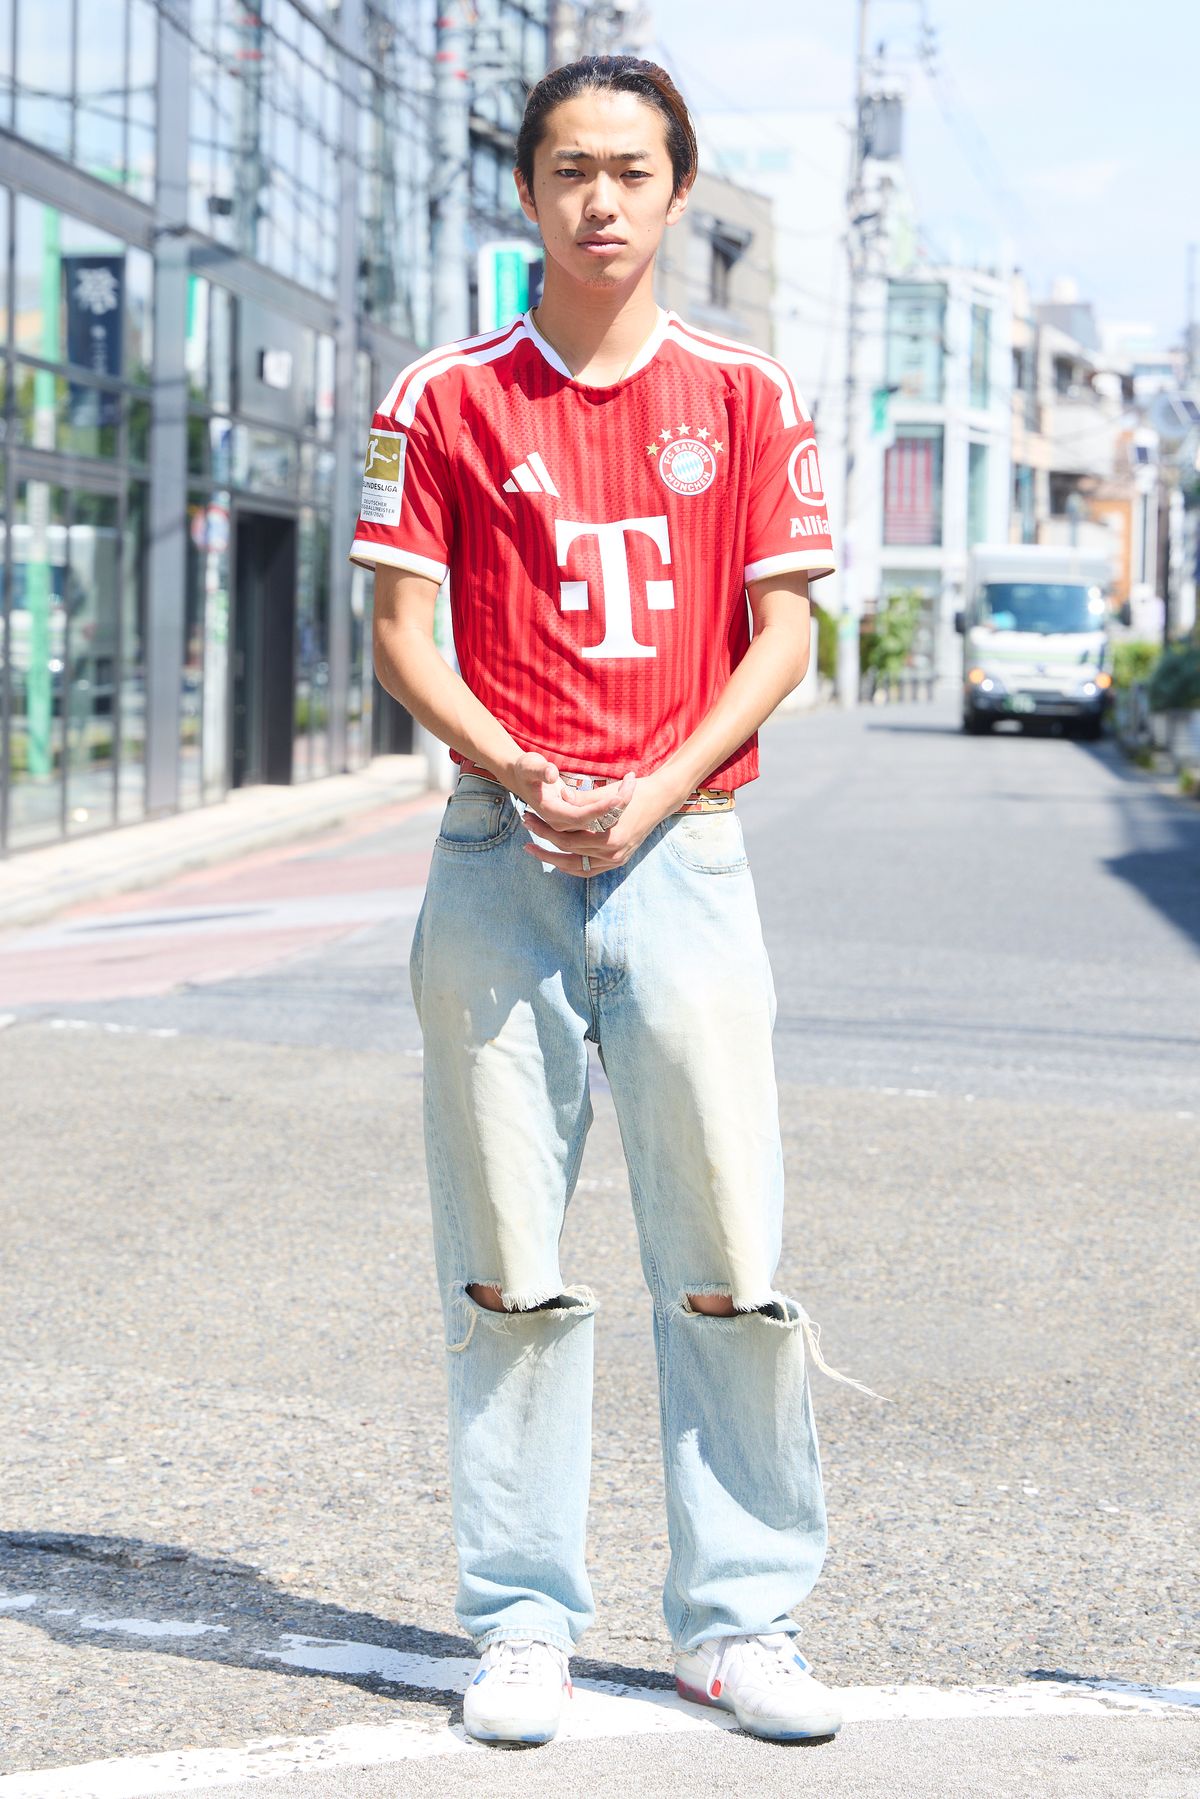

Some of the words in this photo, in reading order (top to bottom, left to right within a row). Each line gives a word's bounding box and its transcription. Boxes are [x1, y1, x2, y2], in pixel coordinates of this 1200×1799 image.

[664, 452, 675, 465] FC
[673, 443, 710, 463] BAYERN
[789, 514, 831, 539] Allia
